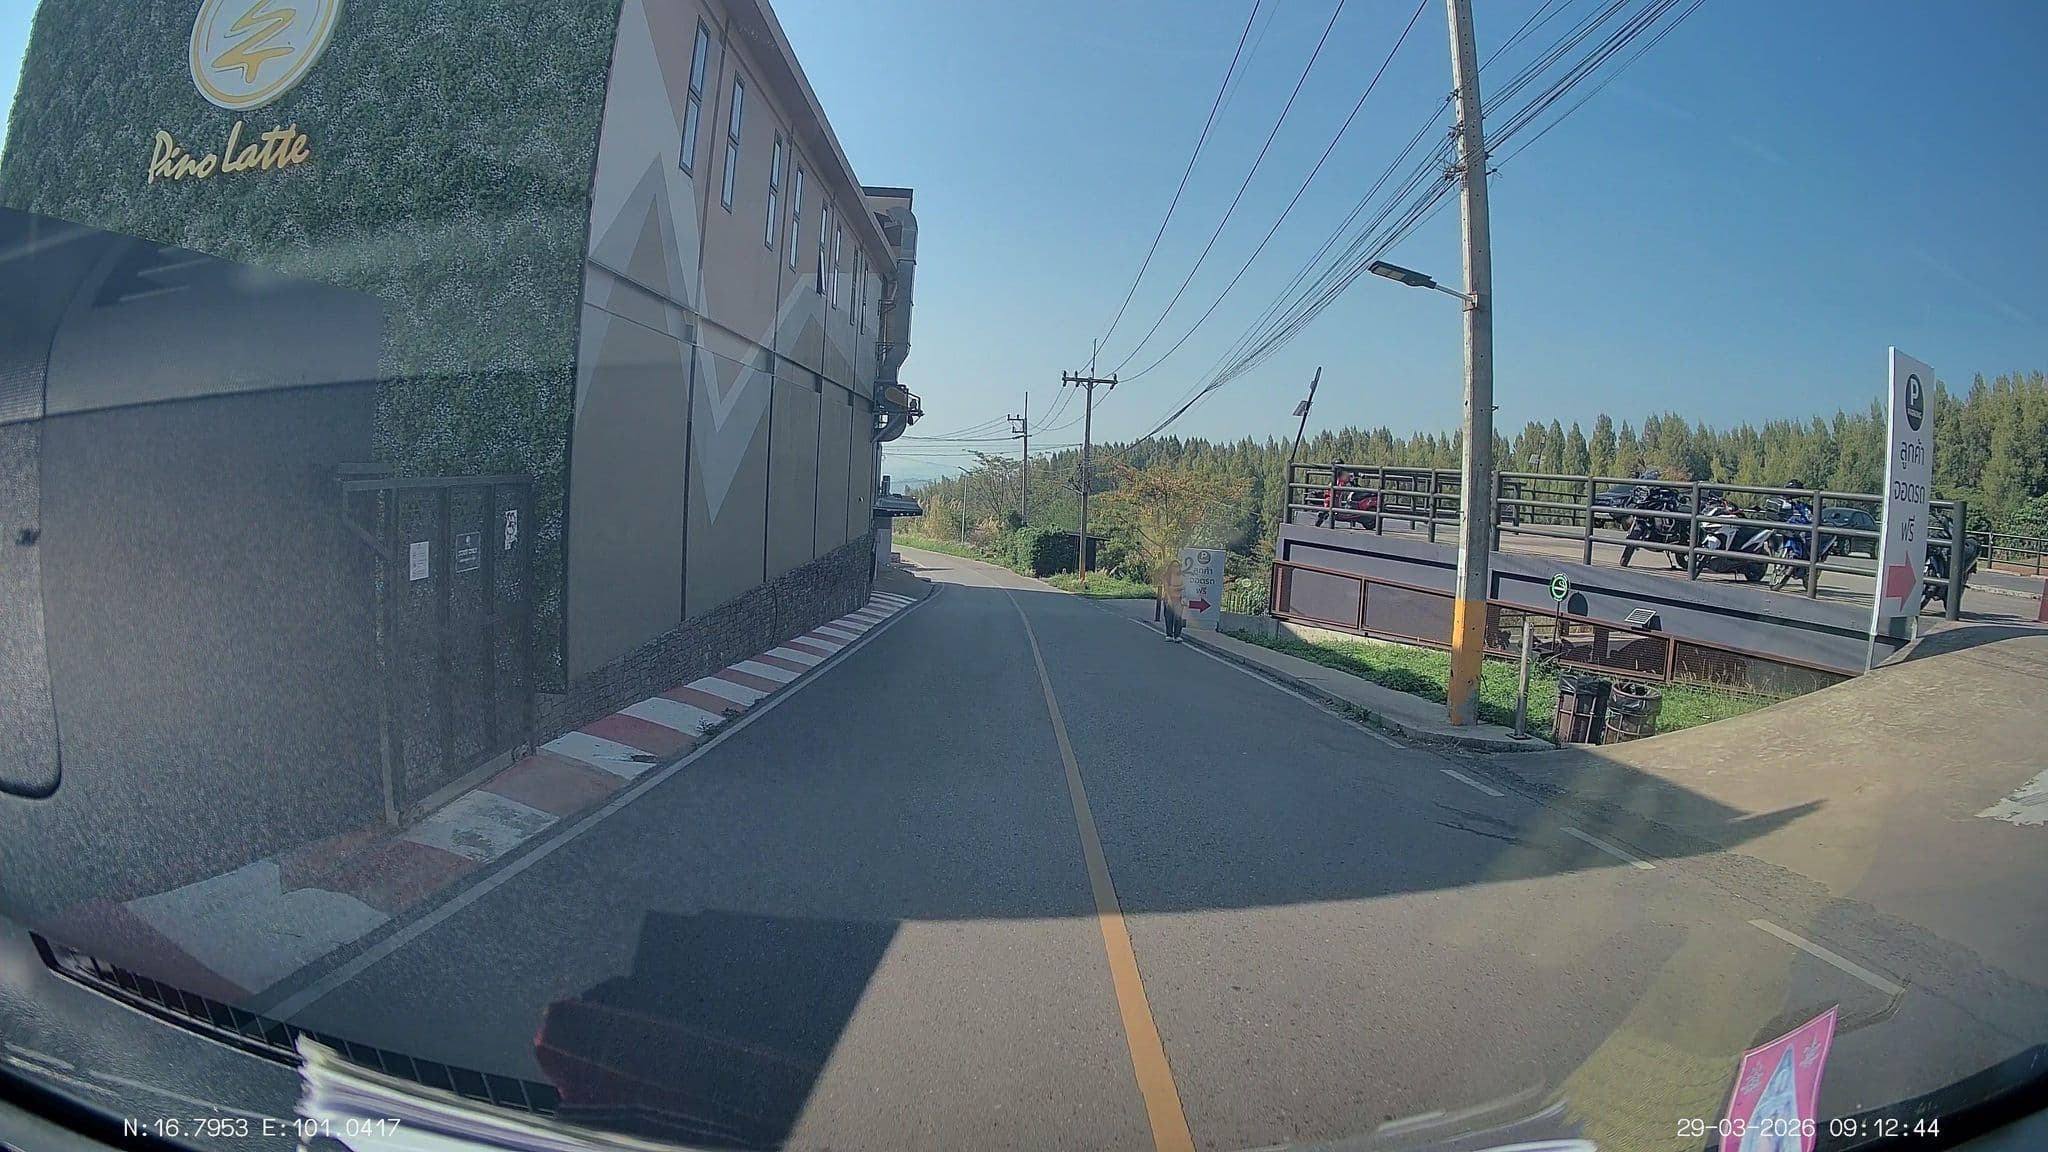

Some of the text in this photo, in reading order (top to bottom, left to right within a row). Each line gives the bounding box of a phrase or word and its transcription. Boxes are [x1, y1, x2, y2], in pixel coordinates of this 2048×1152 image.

[148, 120, 310, 185] Pino Latte
[1910, 378, 1919, 406] P
[1900, 439, 1925, 470] ลูกค้า
[1894, 480, 1926, 505] จอดรถ
[1901, 515, 1916, 542] ฟรี
